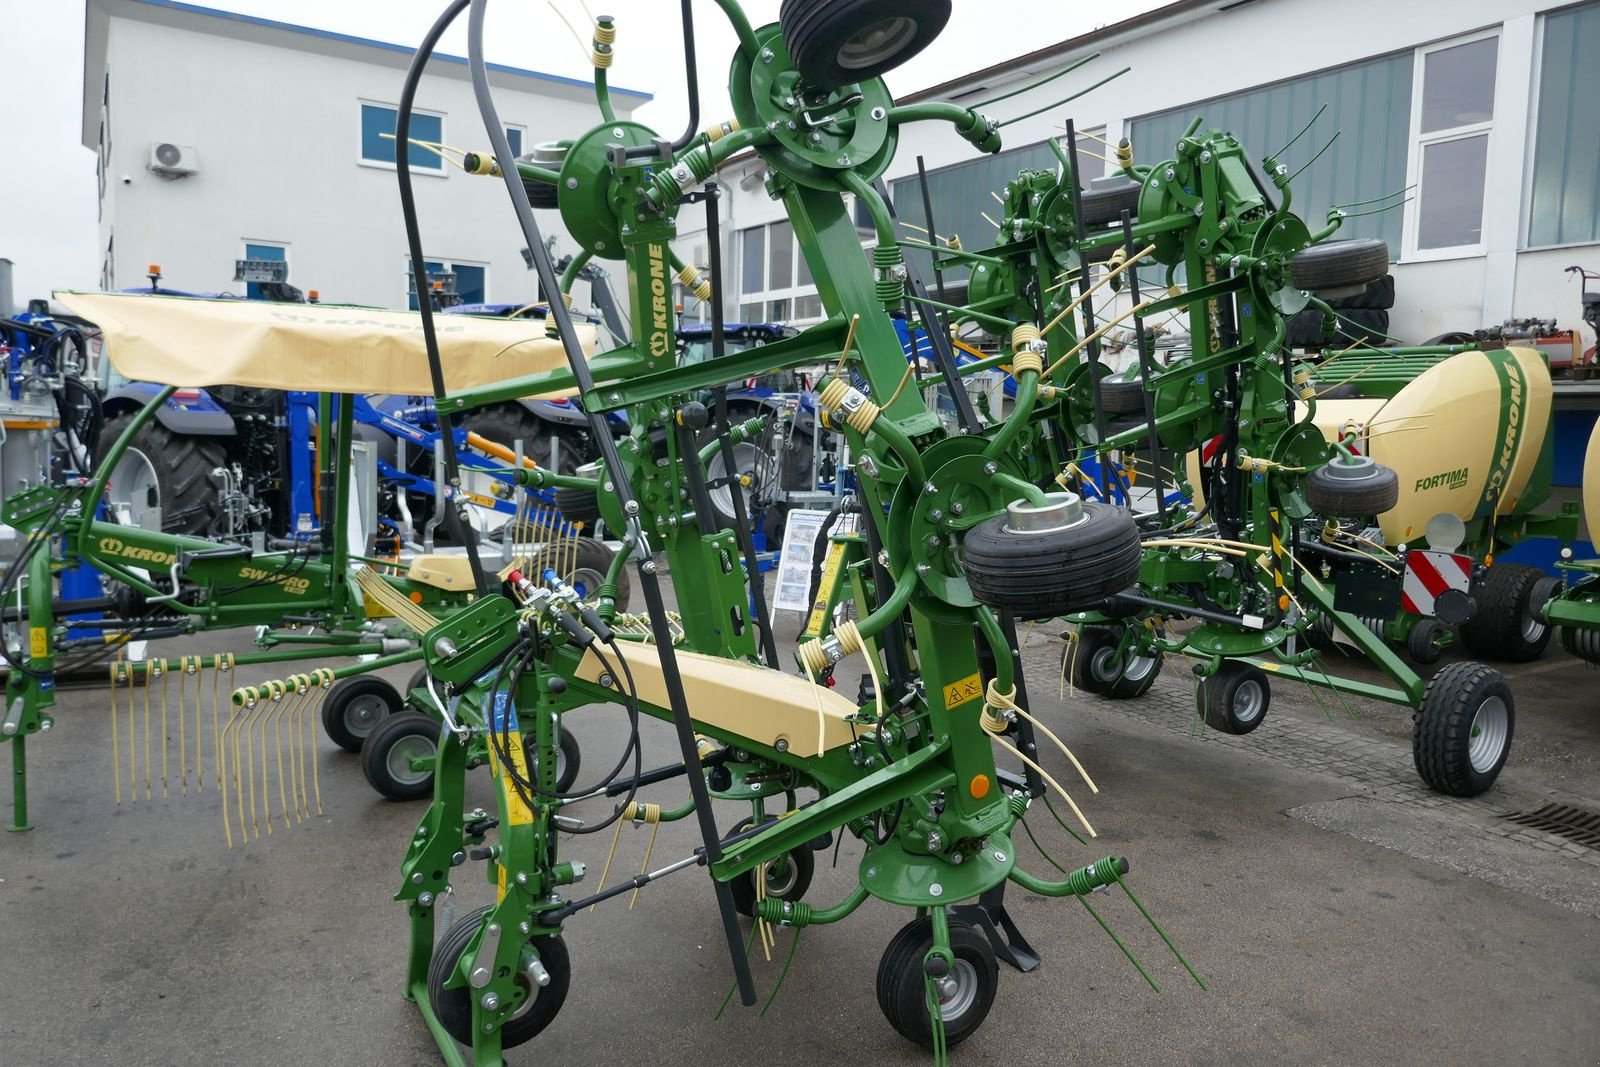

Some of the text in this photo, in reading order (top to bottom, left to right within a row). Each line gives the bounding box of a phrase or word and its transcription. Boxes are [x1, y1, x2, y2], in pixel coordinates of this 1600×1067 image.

[648, 243, 668, 329] KRONE
[1500, 361, 1521, 470] KRONE
[1414, 467, 1468, 493] FORTIMA
[121, 545, 177, 565] KRON
